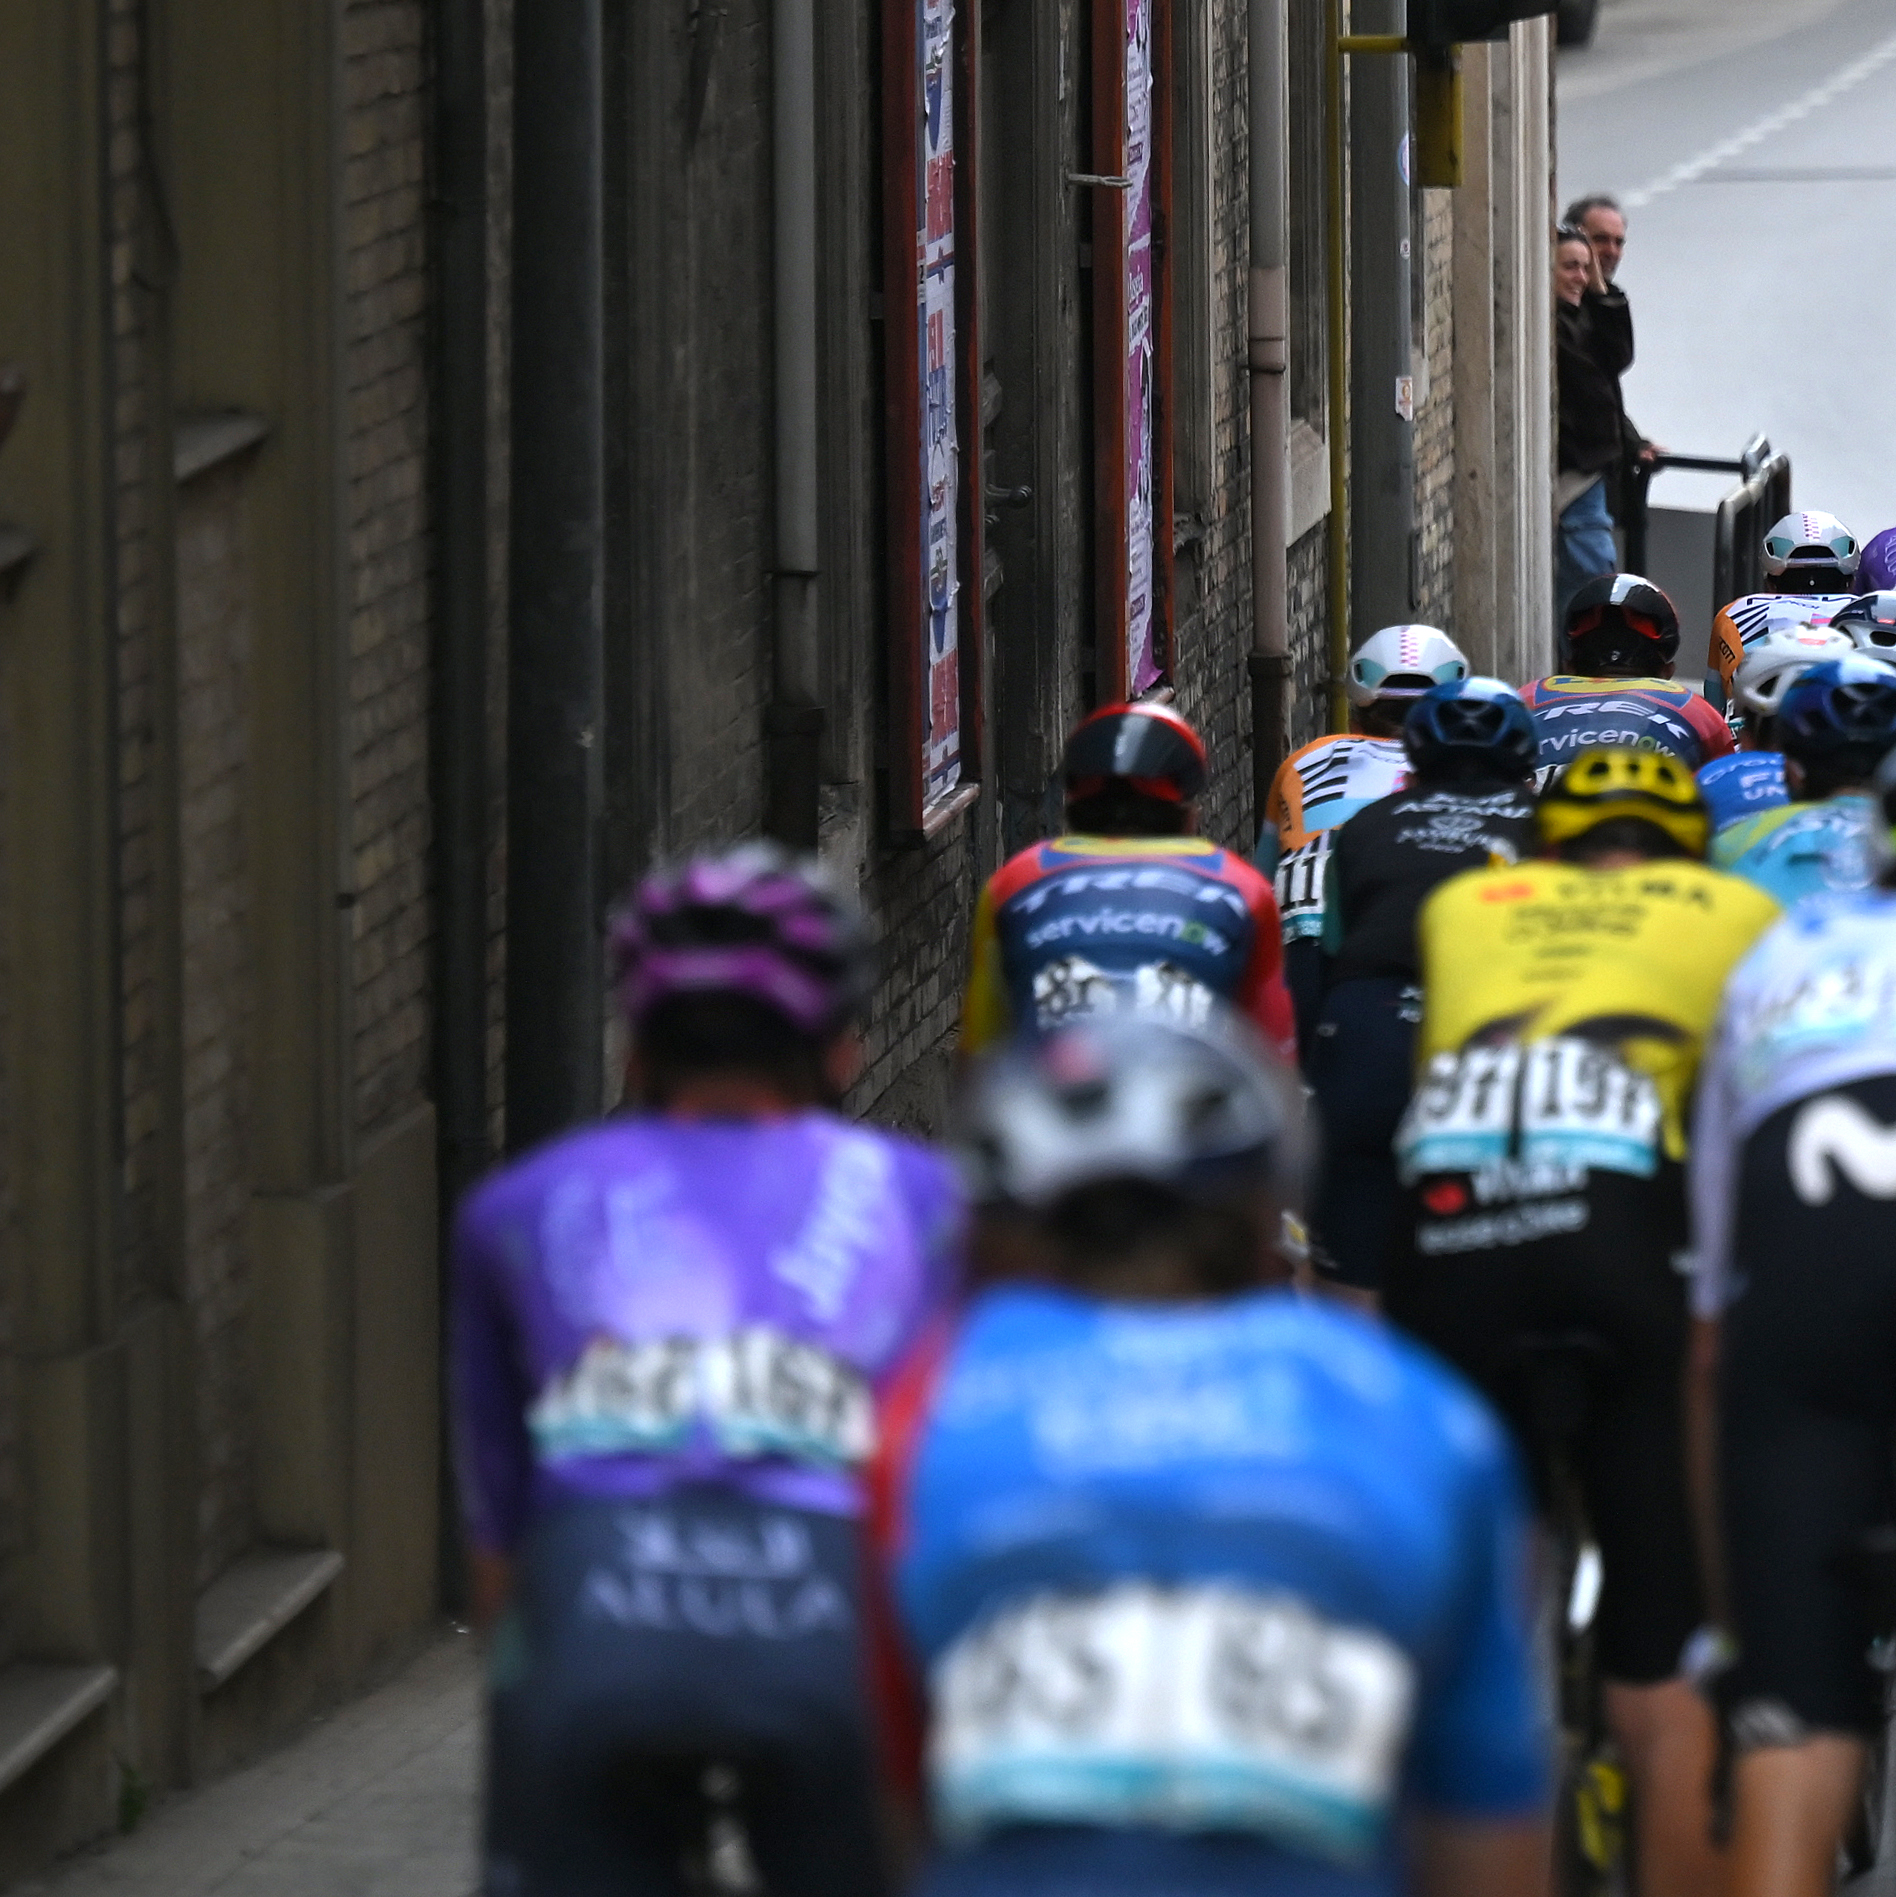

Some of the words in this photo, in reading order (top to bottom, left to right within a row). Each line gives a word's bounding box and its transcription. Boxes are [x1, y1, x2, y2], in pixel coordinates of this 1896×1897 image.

[1542, 702, 1687, 741] TREK
[1538, 727, 1676, 761] rvicenow
[1025, 907, 1230, 957] servicenow
